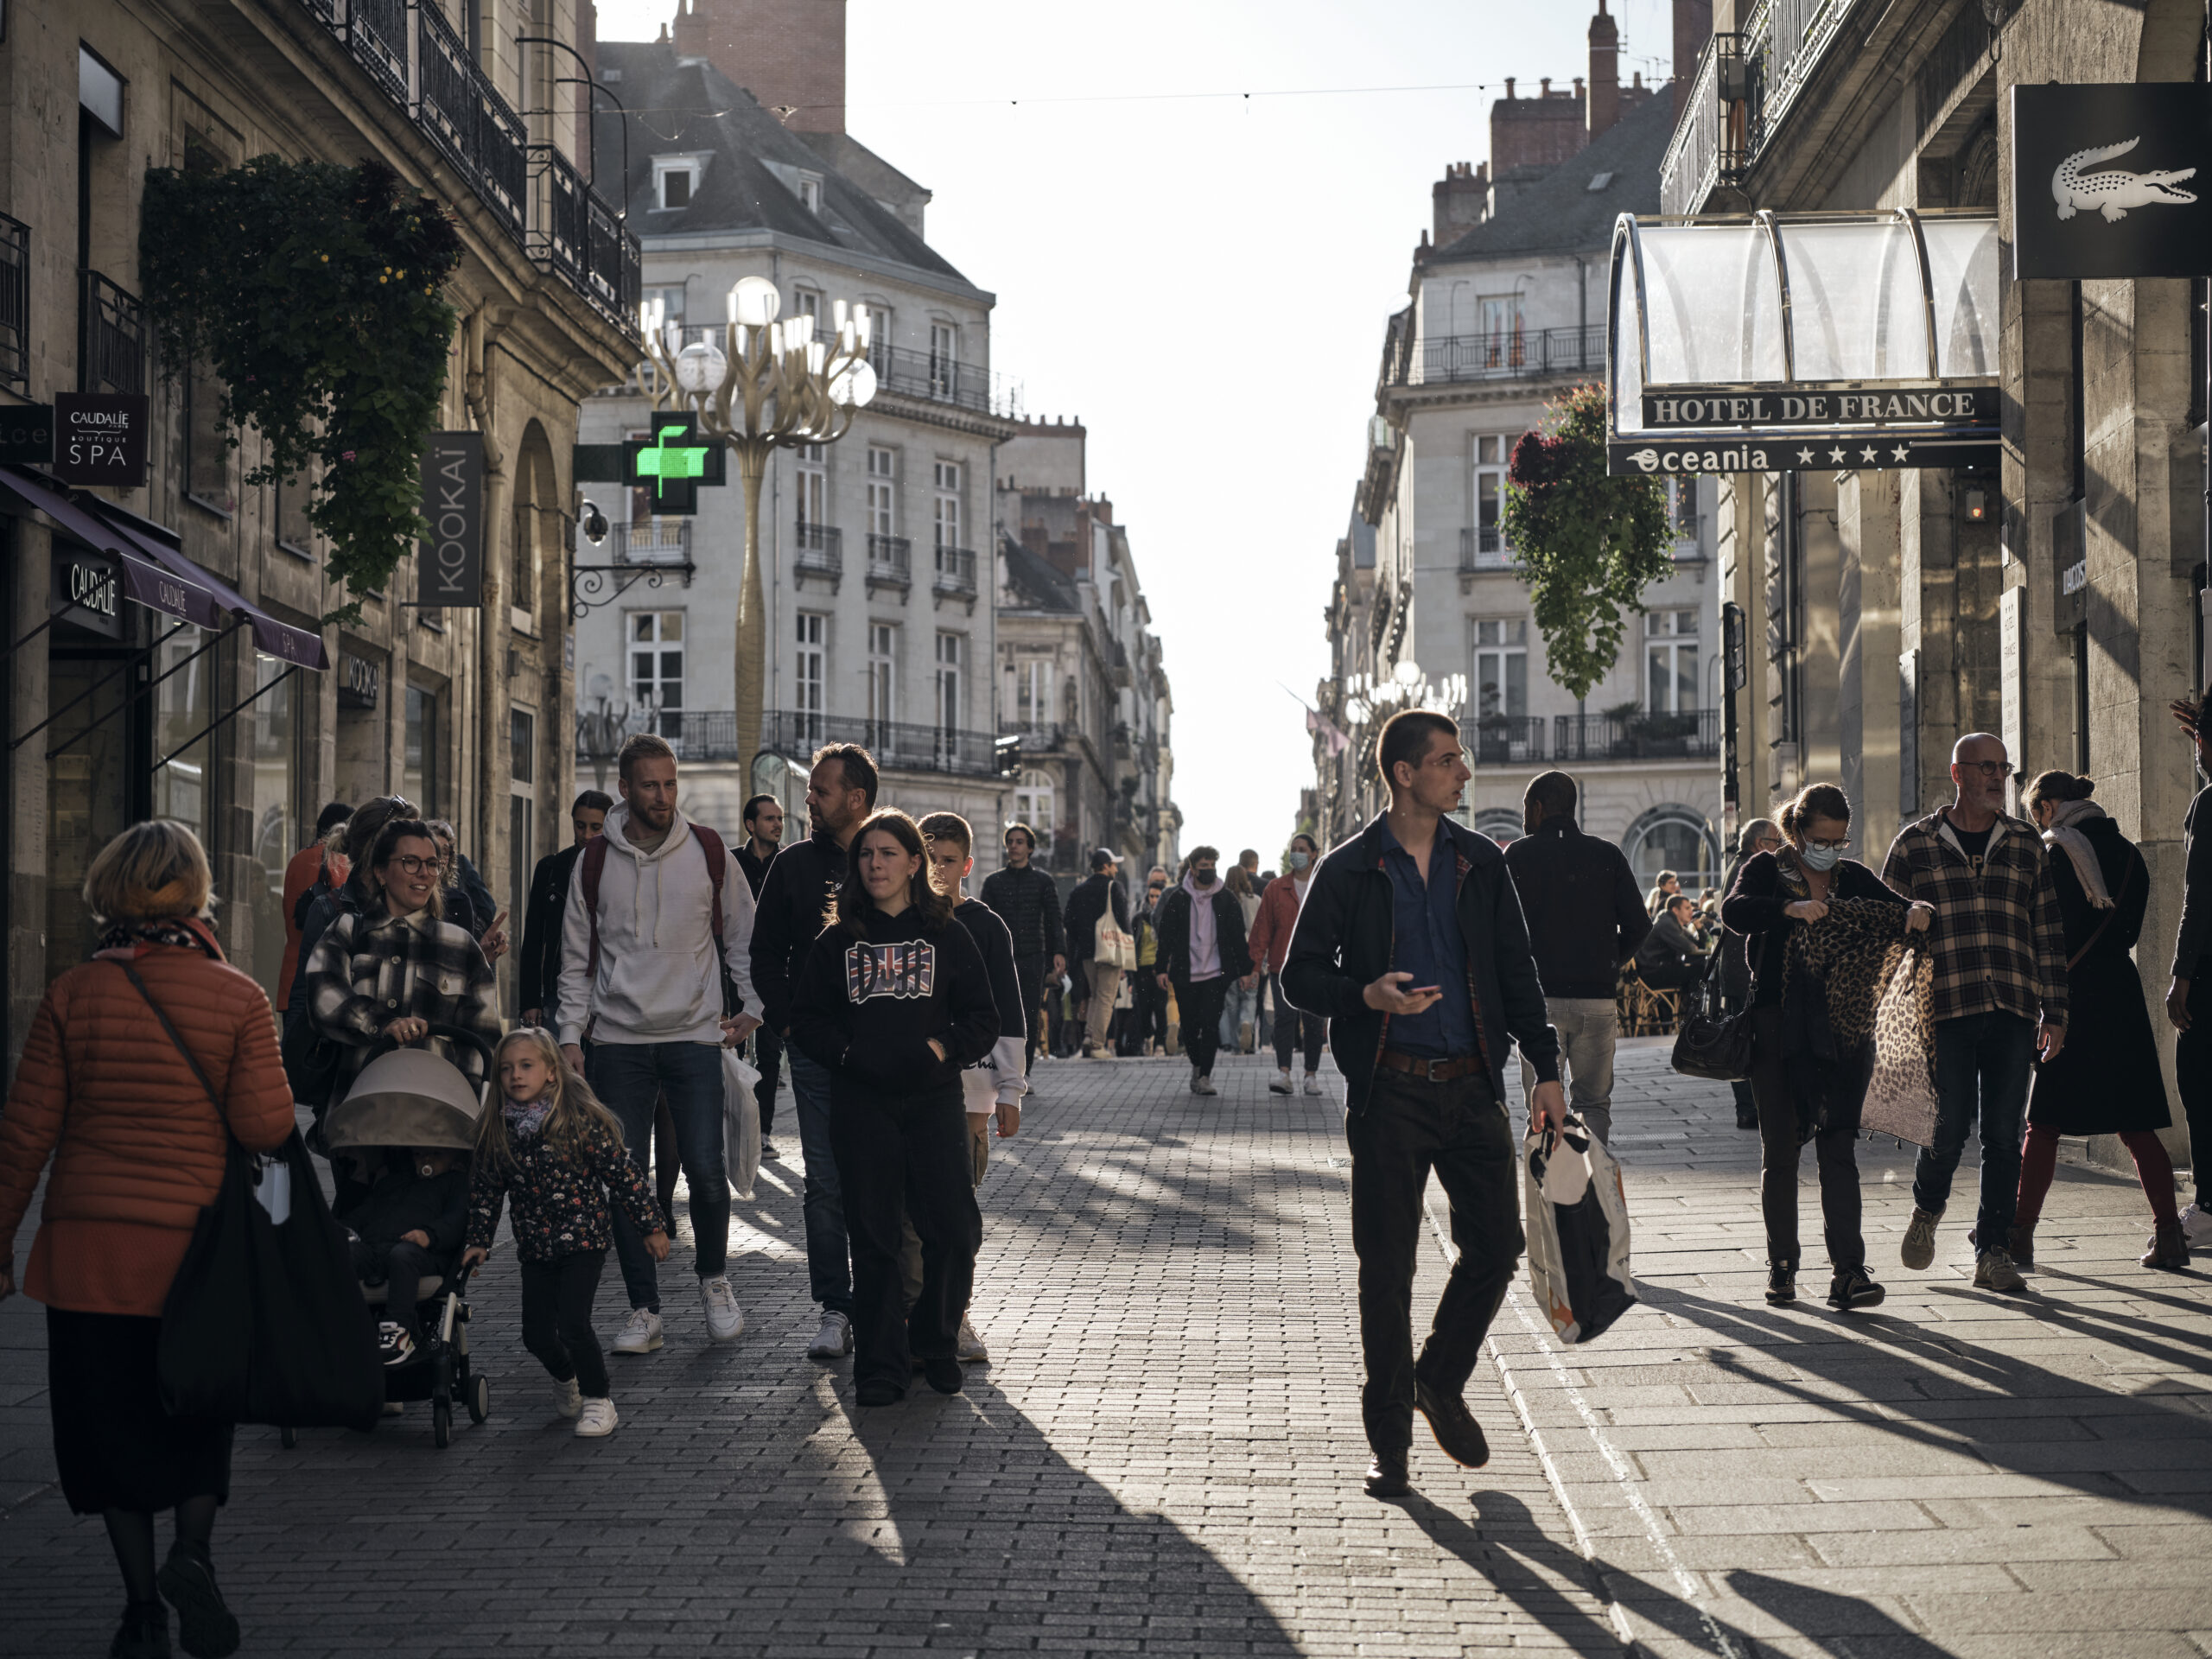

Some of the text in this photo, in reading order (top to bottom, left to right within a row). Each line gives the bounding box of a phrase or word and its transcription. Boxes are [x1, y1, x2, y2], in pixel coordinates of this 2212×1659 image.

[1654, 393, 1975, 423] HOTEL DE FRANCE
[69, 444, 126, 467] SPA
[2063, 559, 2086, 595] LACOS
